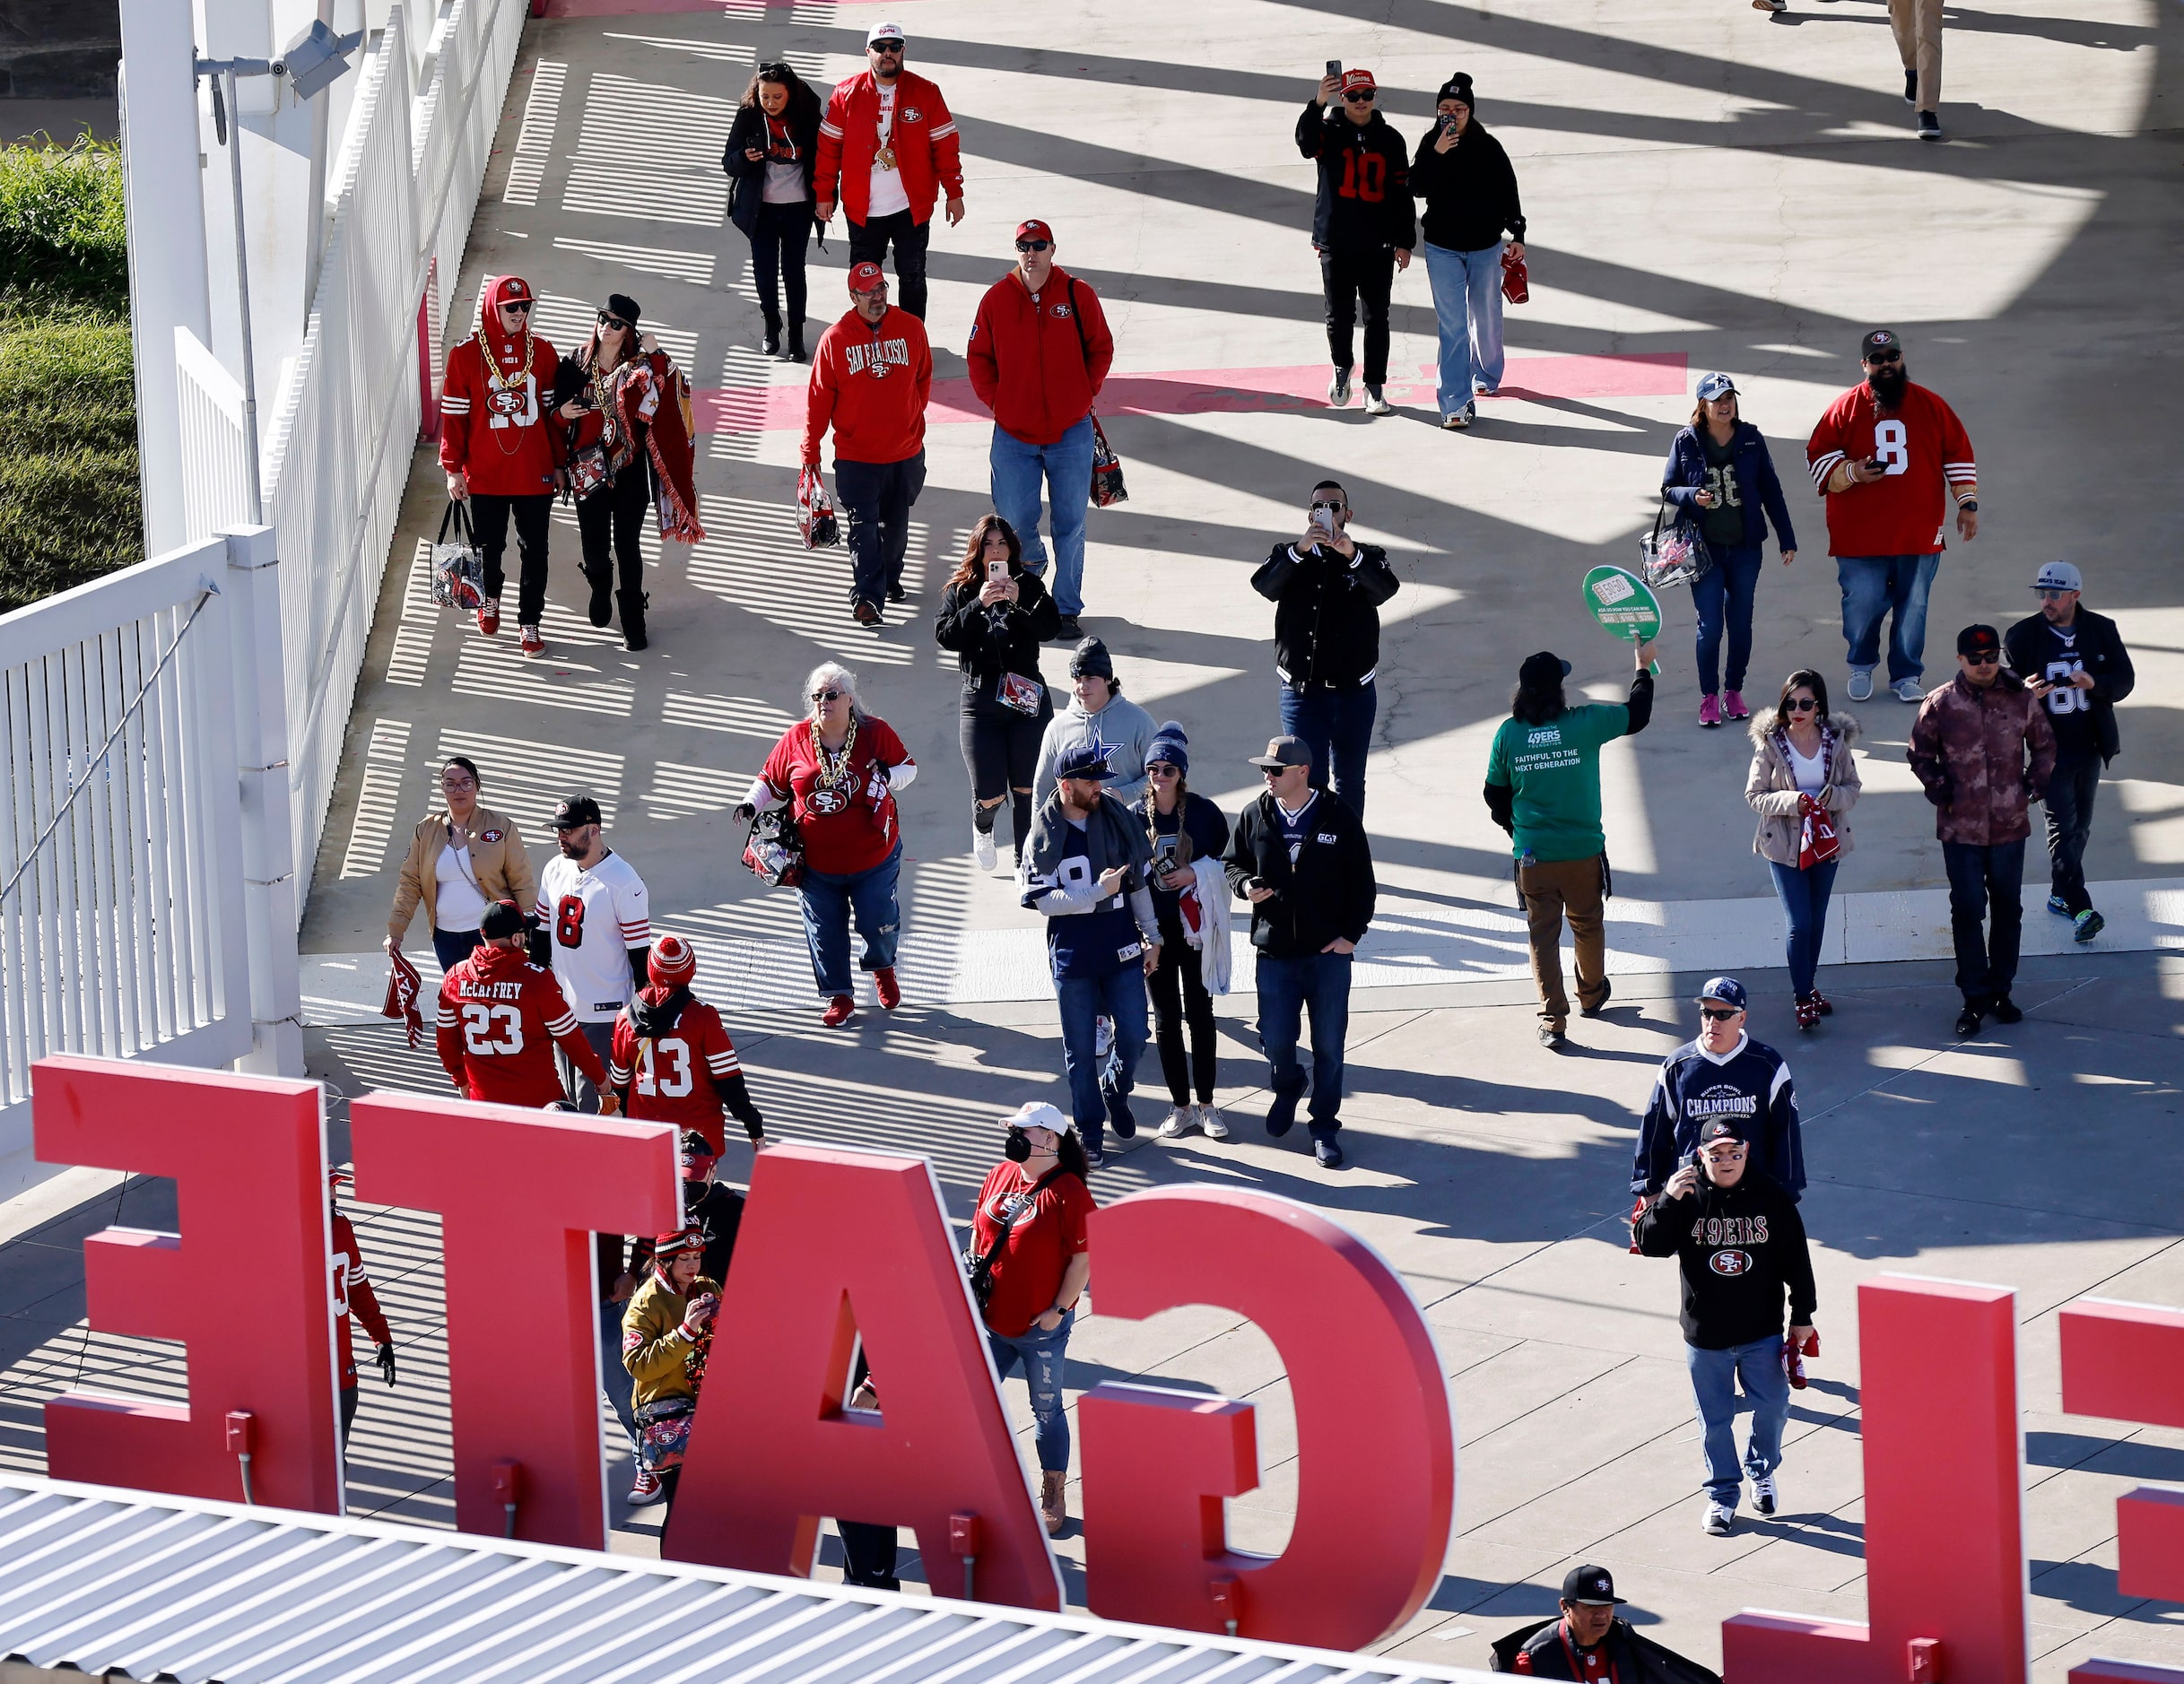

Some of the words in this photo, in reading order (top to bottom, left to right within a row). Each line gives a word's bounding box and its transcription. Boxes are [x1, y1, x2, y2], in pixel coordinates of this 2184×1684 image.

[1339, 148, 1387, 203] 10
[846, 343, 865, 376] SAN
[1874, 419, 1909, 475] 8
[1527, 730, 1561, 744] 49ERS
[1515, 752, 1551, 764] FAITHFUL
[1552, 751, 1562, 759] TO
[1562, 749, 1578, 758] THE
[1515, 764, 1533, 773] NEXT
[1534, 757, 1580, 770] GENERATION
[557, 894, 586, 950] 8
[461, 1003, 524, 1055] 23
[637, 1037, 693, 1098] 13
[1686, 1095, 1757, 1118] CHAMPIONS
[1701, 1084, 1723, 1098] SUPER
[1723, 1084, 1742, 1096] BOWL
[1692, 1215, 1770, 1246] 49ERS
